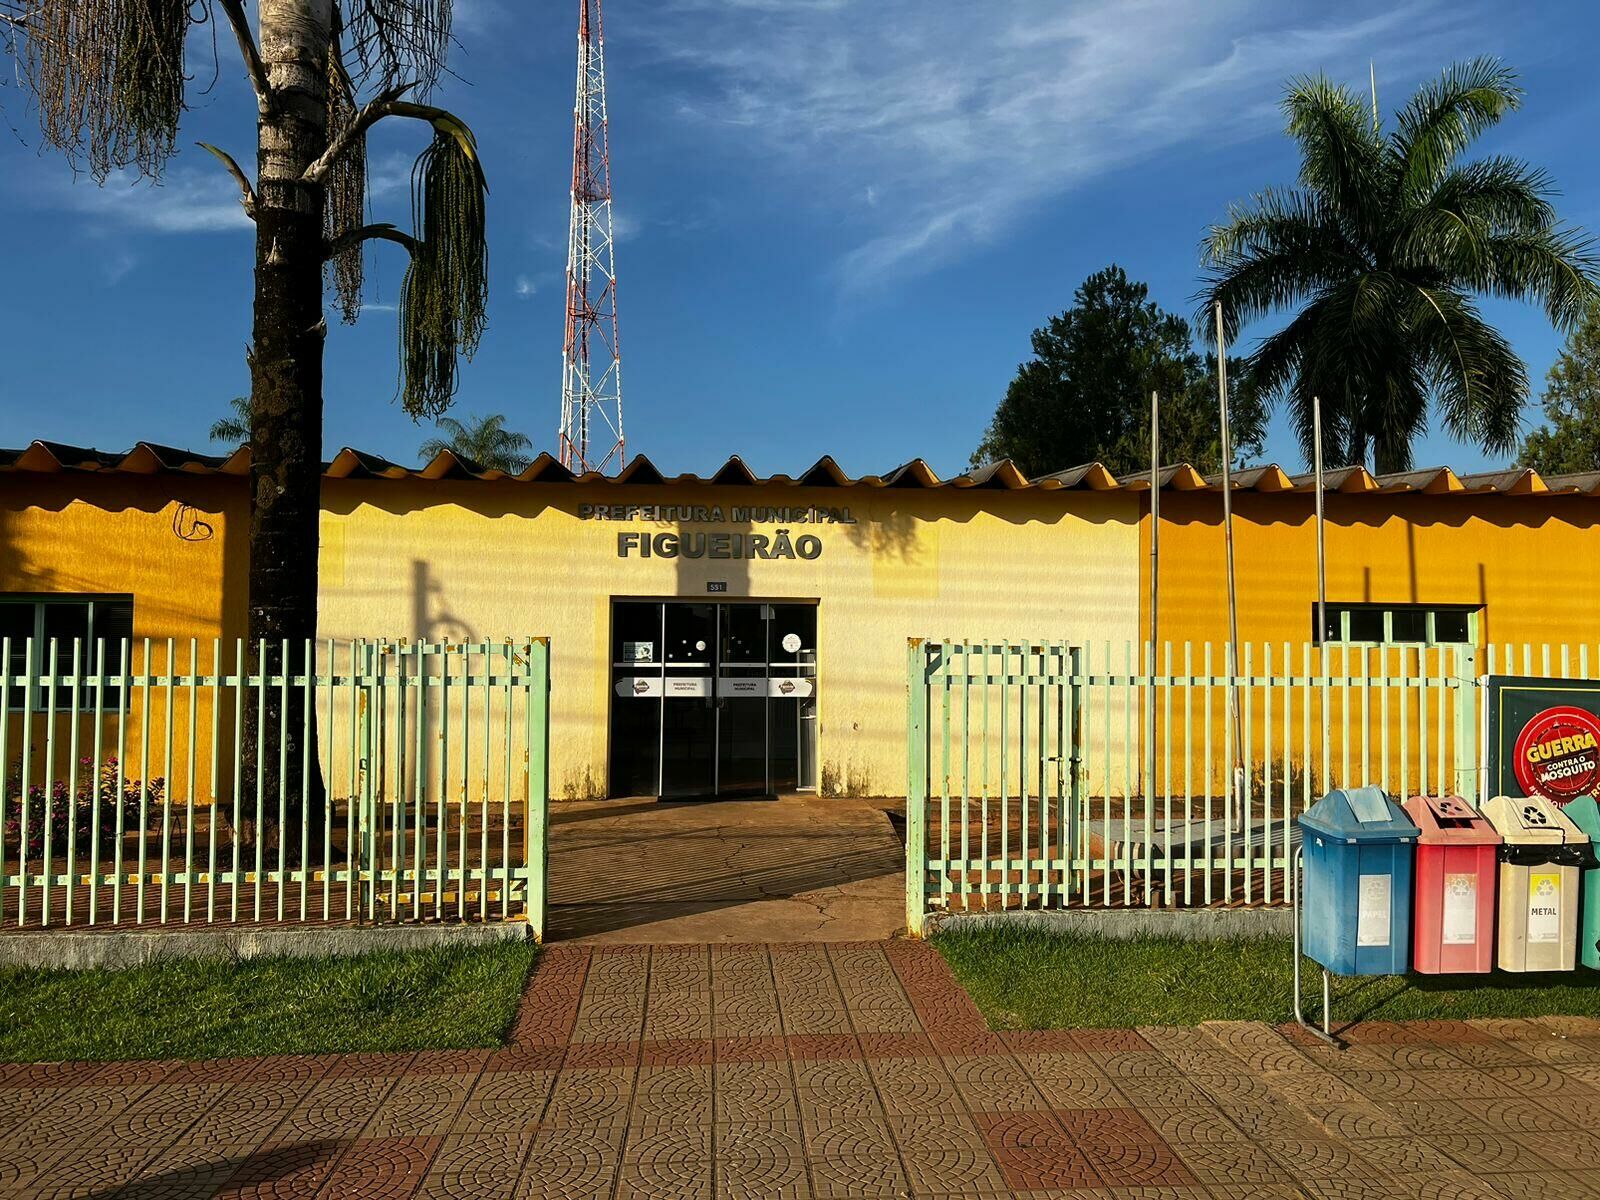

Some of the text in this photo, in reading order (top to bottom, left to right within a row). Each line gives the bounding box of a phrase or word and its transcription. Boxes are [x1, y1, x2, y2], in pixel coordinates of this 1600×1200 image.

[578, 504, 857, 524] PREFEITURA MUNICIPAL
[618, 529, 823, 560] FIGUEIRÃO
[1526, 732, 1598, 763] GUERRA
[1541, 760, 1596, 783] MOSQUITO
[1547, 755, 1586, 771] CONTRA O
[1530, 907, 1557, 917] METAL
